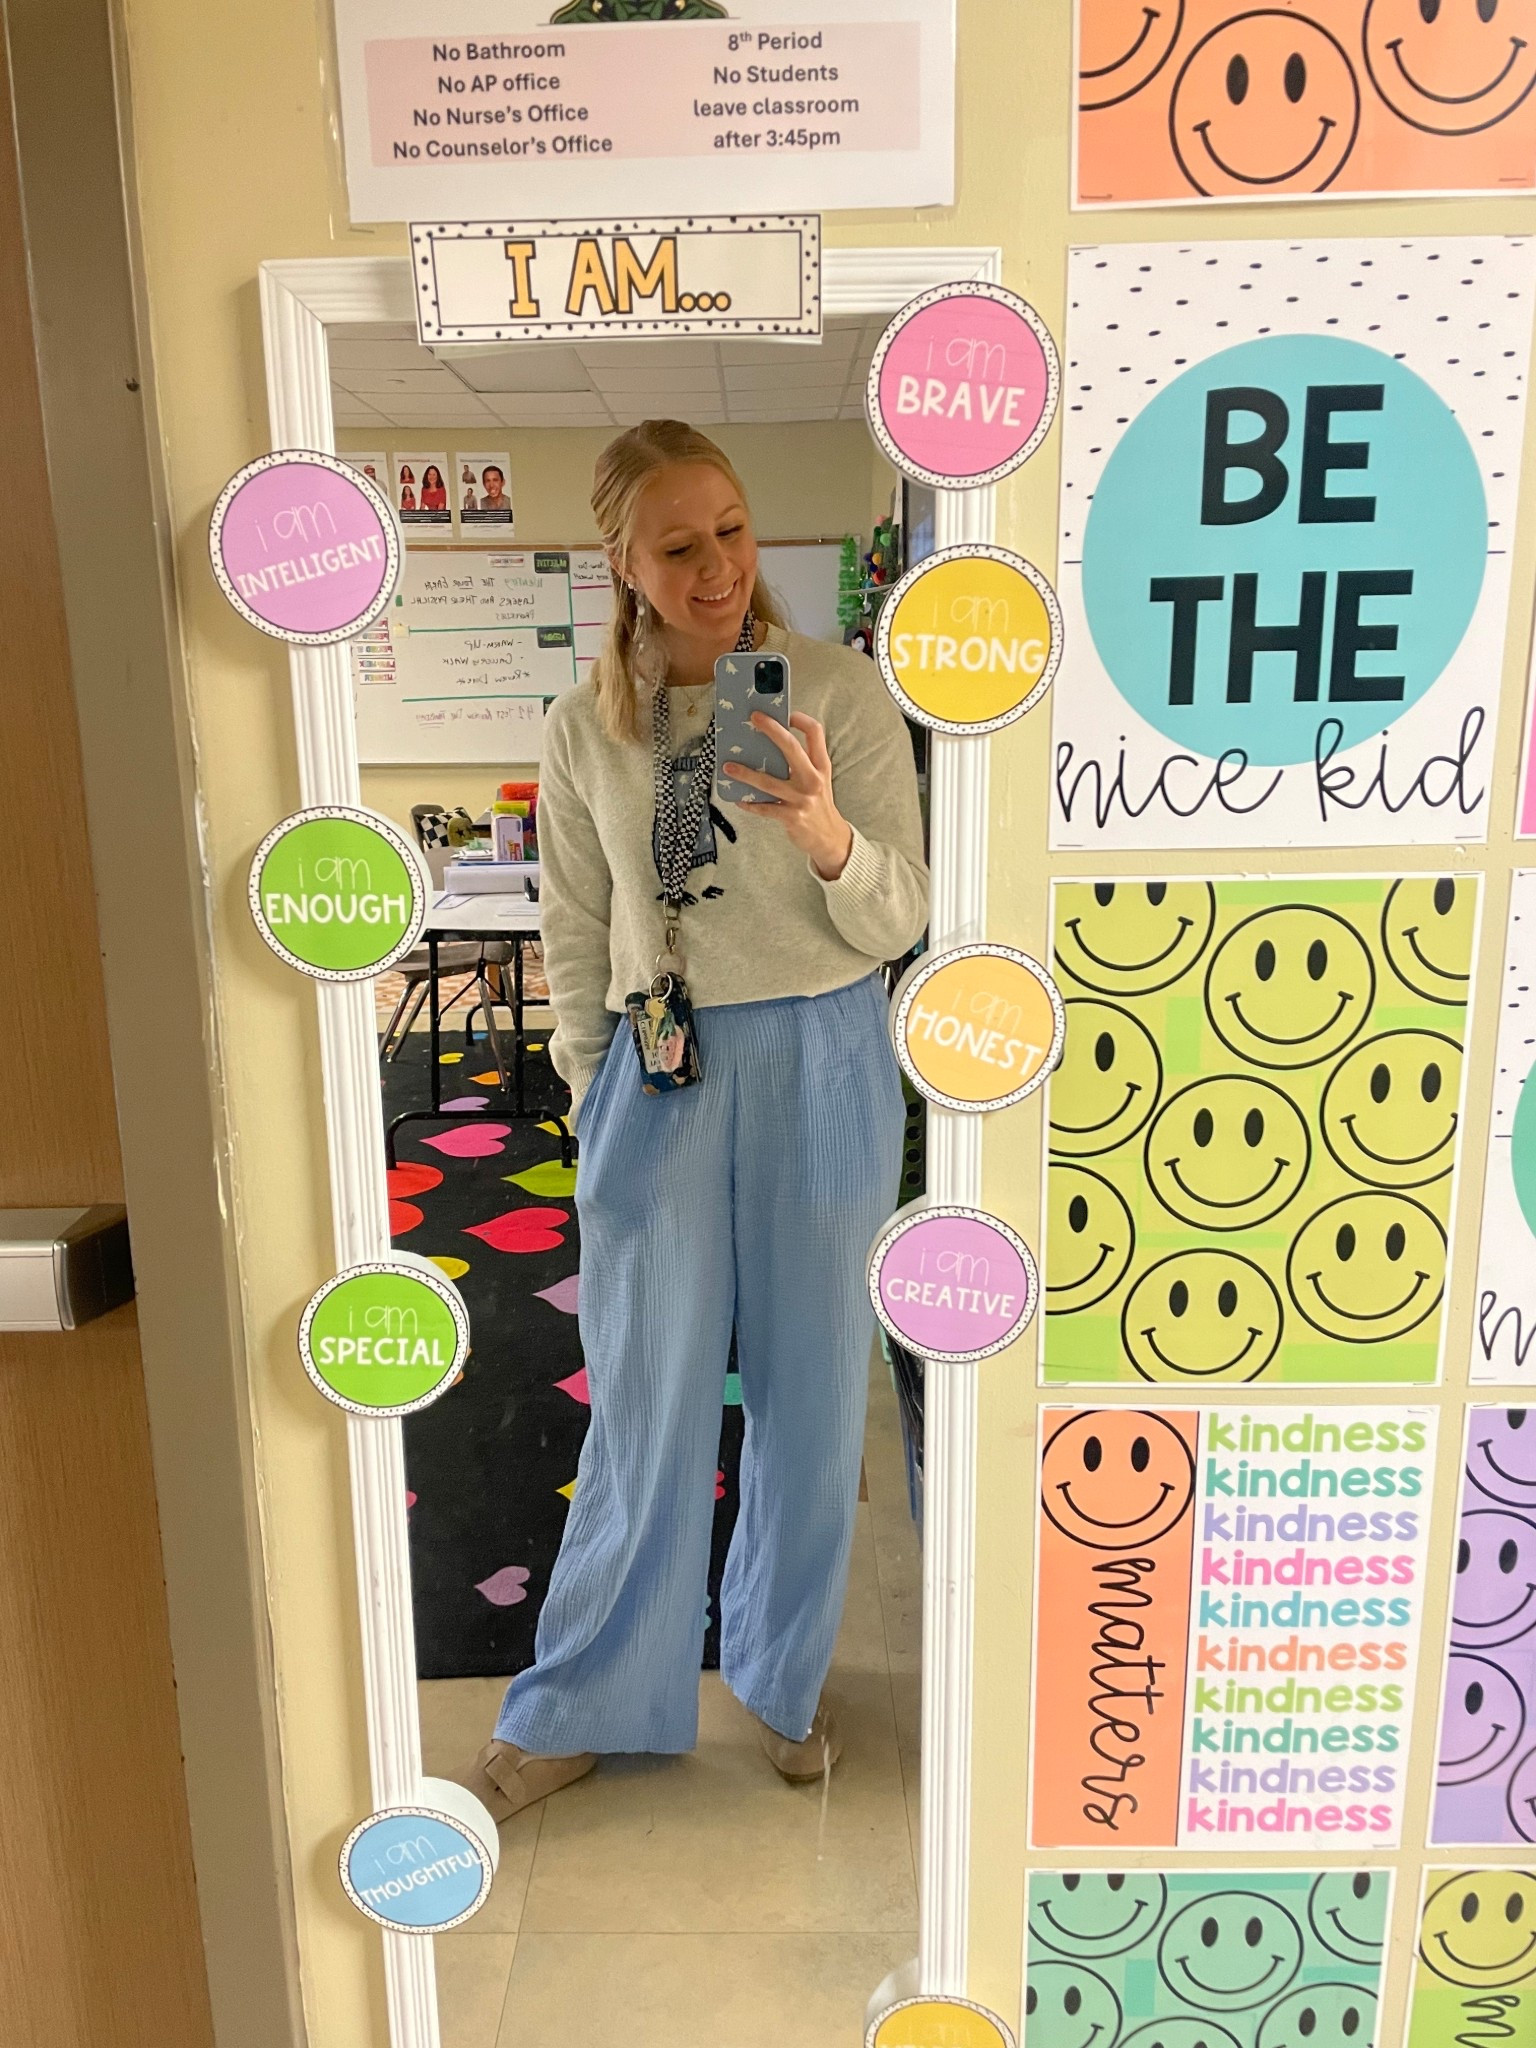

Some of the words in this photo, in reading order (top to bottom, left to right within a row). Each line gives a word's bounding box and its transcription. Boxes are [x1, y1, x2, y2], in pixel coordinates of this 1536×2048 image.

[433, 43, 461, 62] No
[466, 41, 566, 60] Bathroom
[757, 31, 823, 51] Period
[438, 76, 466, 94] No
[471, 75, 498, 92] AP
[503, 72, 561, 91] office
[713, 65, 742, 84] No
[747, 63, 839, 83] Students
[413, 109, 442, 127] No
[447, 106, 522, 125] Nurse's
[528, 103, 589, 123] Office
[694, 98, 746, 117] leave
[754, 96, 860, 116] classroom
[393, 141, 421, 160] No
[426, 137, 547, 157] Counselor's
[552, 135, 613, 154] Office
[713, 130, 760, 149] after
[766, 128, 841, 151] 3:45pm
[505, 240, 540, 318] I
[945, 336, 1007, 380] am
[896, 374, 1026, 427] BRAVE
[1200, 383, 1386, 526] BE
[273, 501, 337, 543] am
[237, 534, 382, 598] INTELLIGENT
[951, 594, 1009, 632] am
[893, 632, 1046, 674] STRONG
[1149, 569, 1414, 706] THE
[1057, 737, 1283, 828] nice
[1315, 706, 1485, 822] kid
[315, 856, 371, 890] am
[265, 893, 407, 924] ENOUGH
[969, 989, 1023, 1035] am
[907, 1004, 1043, 1077] HONEST
[936, 1249, 990, 1286] am
[885, 1277, 1016, 1319] CREATIVE
[364, 1305, 418, 1335] am
[319, 1336, 445, 1366] SPECIAL
[1207, 1412, 1427, 1453] kindness
[1205, 1458, 1423, 1499] kindness
[1203, 1503, 1420, 1543] kindness
[1201, 1548, 1416, 1586] kindness
[1198, 1590, 1412, 1629] kindness
[1196, 1635, 1408, 1673] kindness
[1081, 1557, 1167, 1831] matters
[1194, 1677, 1404, 1714] kindness
[1191, 1717, 1400, 1754] kindness
[1189, 1758, 1397, 1795] kindness
[1186, 1798, 1393, 1834] kindness
[386, 1835, 438, 1866] am
[359, 1849, 483, 1907] THOUGHTFUL
